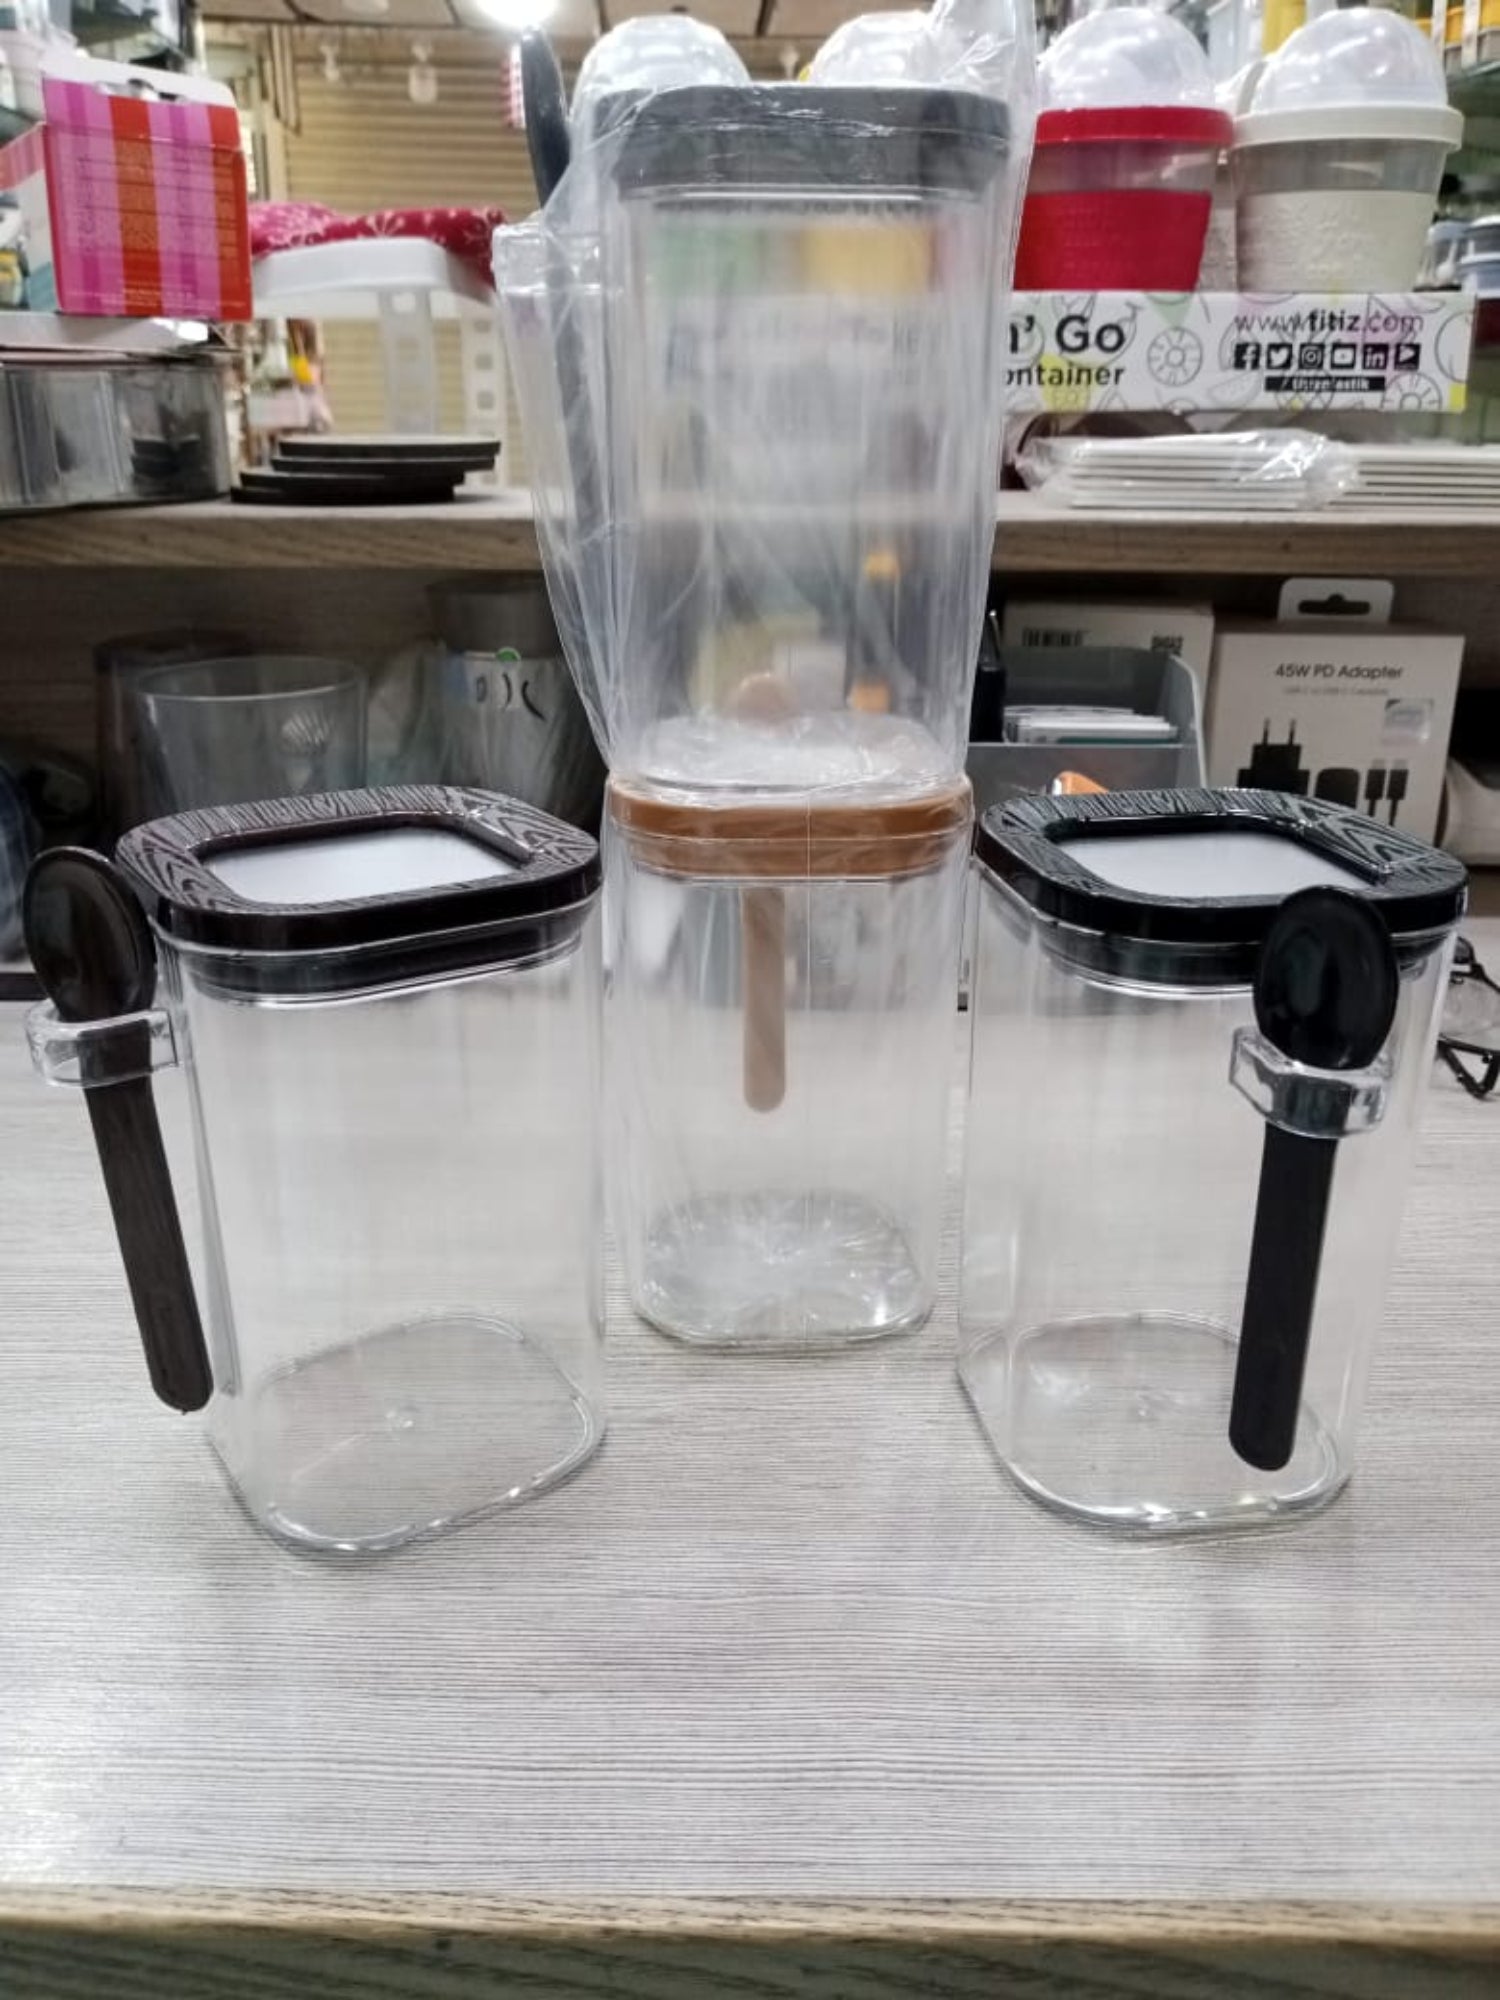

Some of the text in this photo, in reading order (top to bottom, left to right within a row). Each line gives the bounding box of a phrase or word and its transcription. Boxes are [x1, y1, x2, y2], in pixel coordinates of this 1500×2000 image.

[1055, 314, 1126, 353] Go
[1275, 662, 1404, 680] 45W PD Adapter
